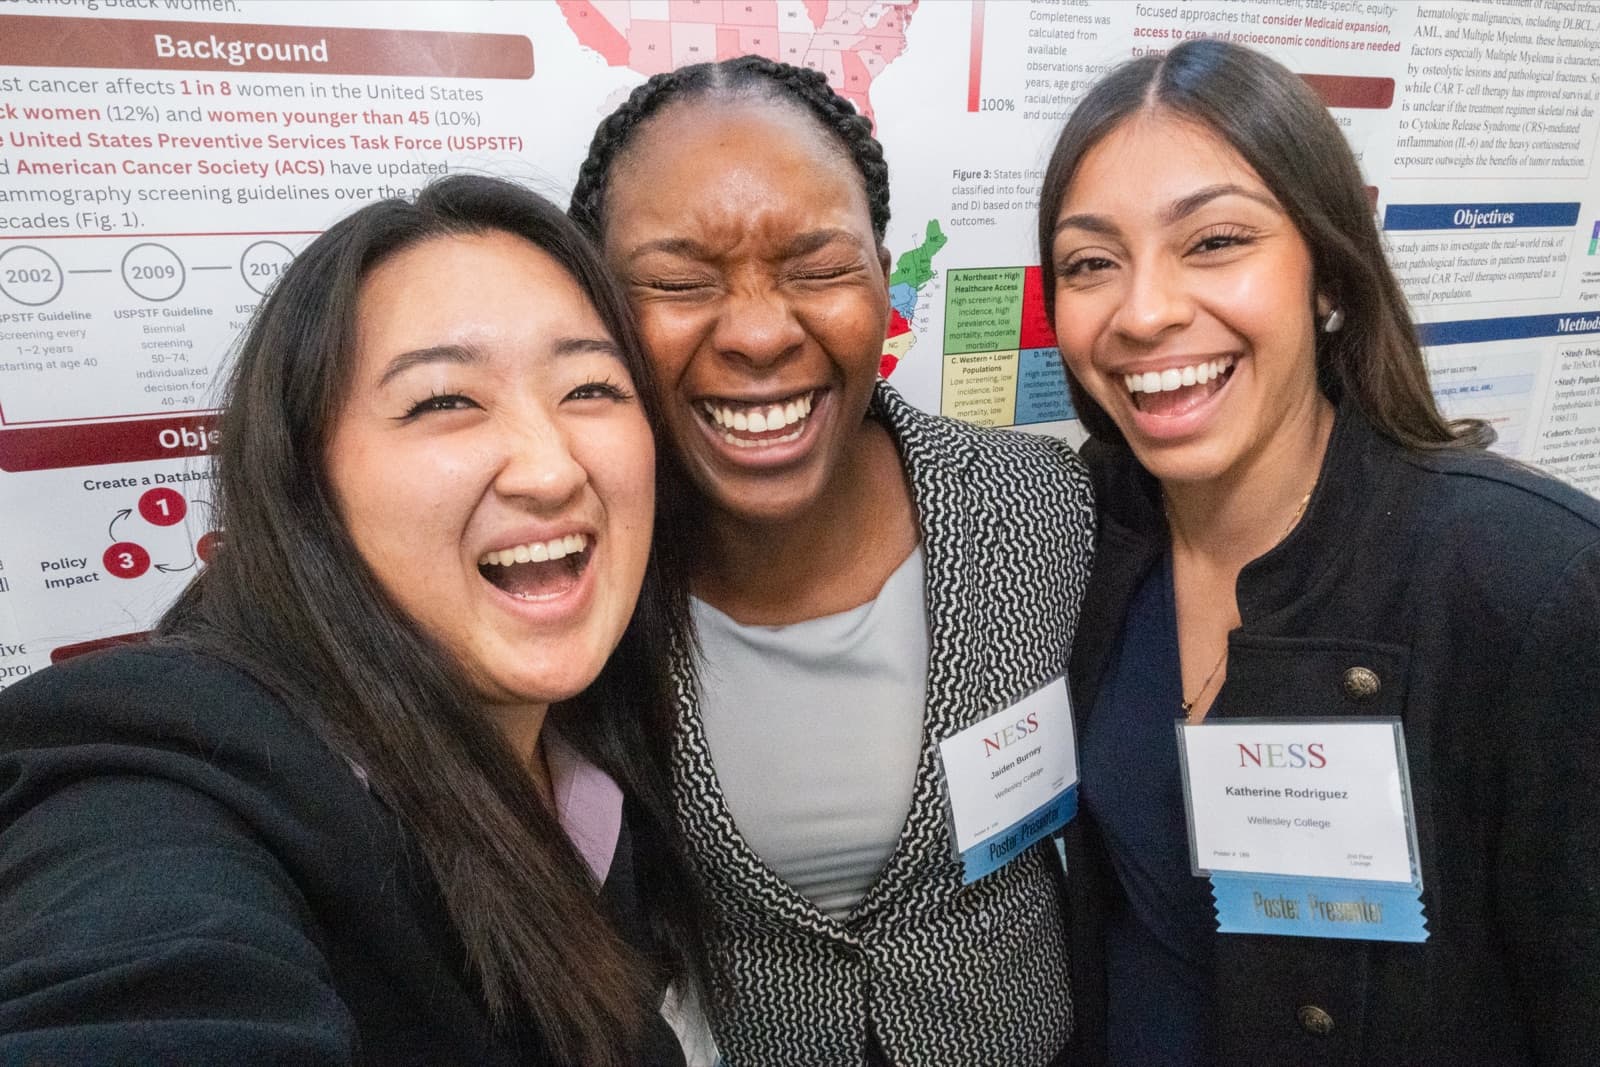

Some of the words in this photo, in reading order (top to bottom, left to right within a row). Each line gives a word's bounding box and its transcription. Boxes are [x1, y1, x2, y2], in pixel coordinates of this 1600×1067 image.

[1029, 10, 1093, 24] Completeness
[1094, 15, 1111, 25] was
[1136, 4, 1178, 18] focused
[1180, 8, 1238, 23] approaches
[1240, 11, 1261, 24] that
[1262, 14, 1302, 27] consider
[1304, 16, 1344, 30] Medicaid
[1345, 21, 1391, 36] expansion,
[1028, 27, 1075, 40] calculated
[1077, 30, 1098, 41] from
[1133, 27, 1169, 38] access
[1171, 28, 1182, 39] to
[1232, 31, 1303, 46] socioeconomic
[1304, 37, 1350, 49] conditions
[1350, 40, 1365, 50] are
[1366, 40, 1401, 52] needed
[154, 34, 329, 64] Background
[1027, 45, 1068, 56] available
[1026, 62, 1084, 73] observations
[29, 80, 99, 94] cancer
[106, 77, 176, 95] affects
[180, 80, 192, 95] 1
[196, 80, 214, 95] in
[220, 81, 232, 96] 8
[237, 84, 305, 98] women
[310, 82, 327, 98] in
[332, 83, 362, 99] the
[367, 84, 425, 101] United
[430, 85, 484, 101] States
[1053, 80, 1070, 91] age
[981, 98, 1015, 112] 100%
[23, 106, 101, 121] women
[106, 105, 160, 123] (12%)
[166, 106, 202, 122] and
[207, 109, 278, 123] women
[282, 111, 358, 128] younger
[362, 109, 404, 125] than
[408, 110, 430, 125] 45
[435, 111, 481, 128] (10%)
[1023, 110, 1040, 120] and
[9, 131, 82, 149] United
[88, 132, 153, 149] States
[158, 133, 263, 149] Preventive
[268, 134, 346, 149] Services
[350, 134, 390, 150] Task
[394, 135, 443, 150] Force
[447, 135, 523, 152] (USPSTF)
[17, 159, 116, 175] American
[122, 160, 192, 175] Cancer
[198, 159, 269, 178] Society
[274, 159, 326, 176] (ACS)
[330, 159, 373, 175] have
[378, 160, 449, 179] updated
[953, 169, 983, 181] Figure
[993, 169, 1022, 180] States
[139, 186, 233, 204] screening
[237, 185, 330, 204] guidelines
[335, 188, 372, 200] over
[378, 185, 407, 200] the
[951, 184, 994, 196] classified
[996, 185, 1015, 195] into
[1015, 184, 1034, 195] four
[951, 201, 969, 211] and
[983, 200, 1010, 211] based
[1011, 202, 1024, 210] on
[75, 212, 117, 231] (Fig.
[122, 211, 145, 229] 1).
[1453, 209, 1516, 228] Objectives
[5, 268, 54, 284] 2002
[131, 265, 176, 280] 2009
[0, 312, 35, 323] PSTF
[38, 311, 93, 321] Guideline
[114, 308, 158, 320] USPSTF
[162, 306, 214, 317] Guideline
[56, 329, 87, 341] every
[143, 323, 186, 335] Biennial
[41, 345, 73, 357] years
[141, 337, 193, 350] screening
[46, 360, 57, 369] at
[60, 359, 81, 371] age
[83, 358, 98, 368] 40
[136, 366, 208, 379] individualized
[144, 381, 189, 393] decision
[159, 425, 222, 451] Obje
[84, 477, 137, 491] Create
[141, 476, 152, 485] a
[156, 498, 170, 516] 1
[41, 557, 88, 574] Policy
[118, 552, 135, 569] 3
[45, 572, 100, 590] Impact
[983, 713, 1039, 758] NESS
[991, 762, 1015, 780] Jaiden
[1016, 745, 1043, 765] Burney
[1235, 742, 1328, 769] NESS
[1225, 786, 1281, 798] Katherine
[1284, 787, 1349, 801] Rodriguez
[1247, 815, 1291, 828] Wellesley
[1294, 817, 1332, 829] College
[989, 833, 1018, 862] Poster
[1022, 808, 1060, 840] Presenter
[1253, 890, 1300, 920] Poster
[1308, 894, 1384, 925] Presenter
